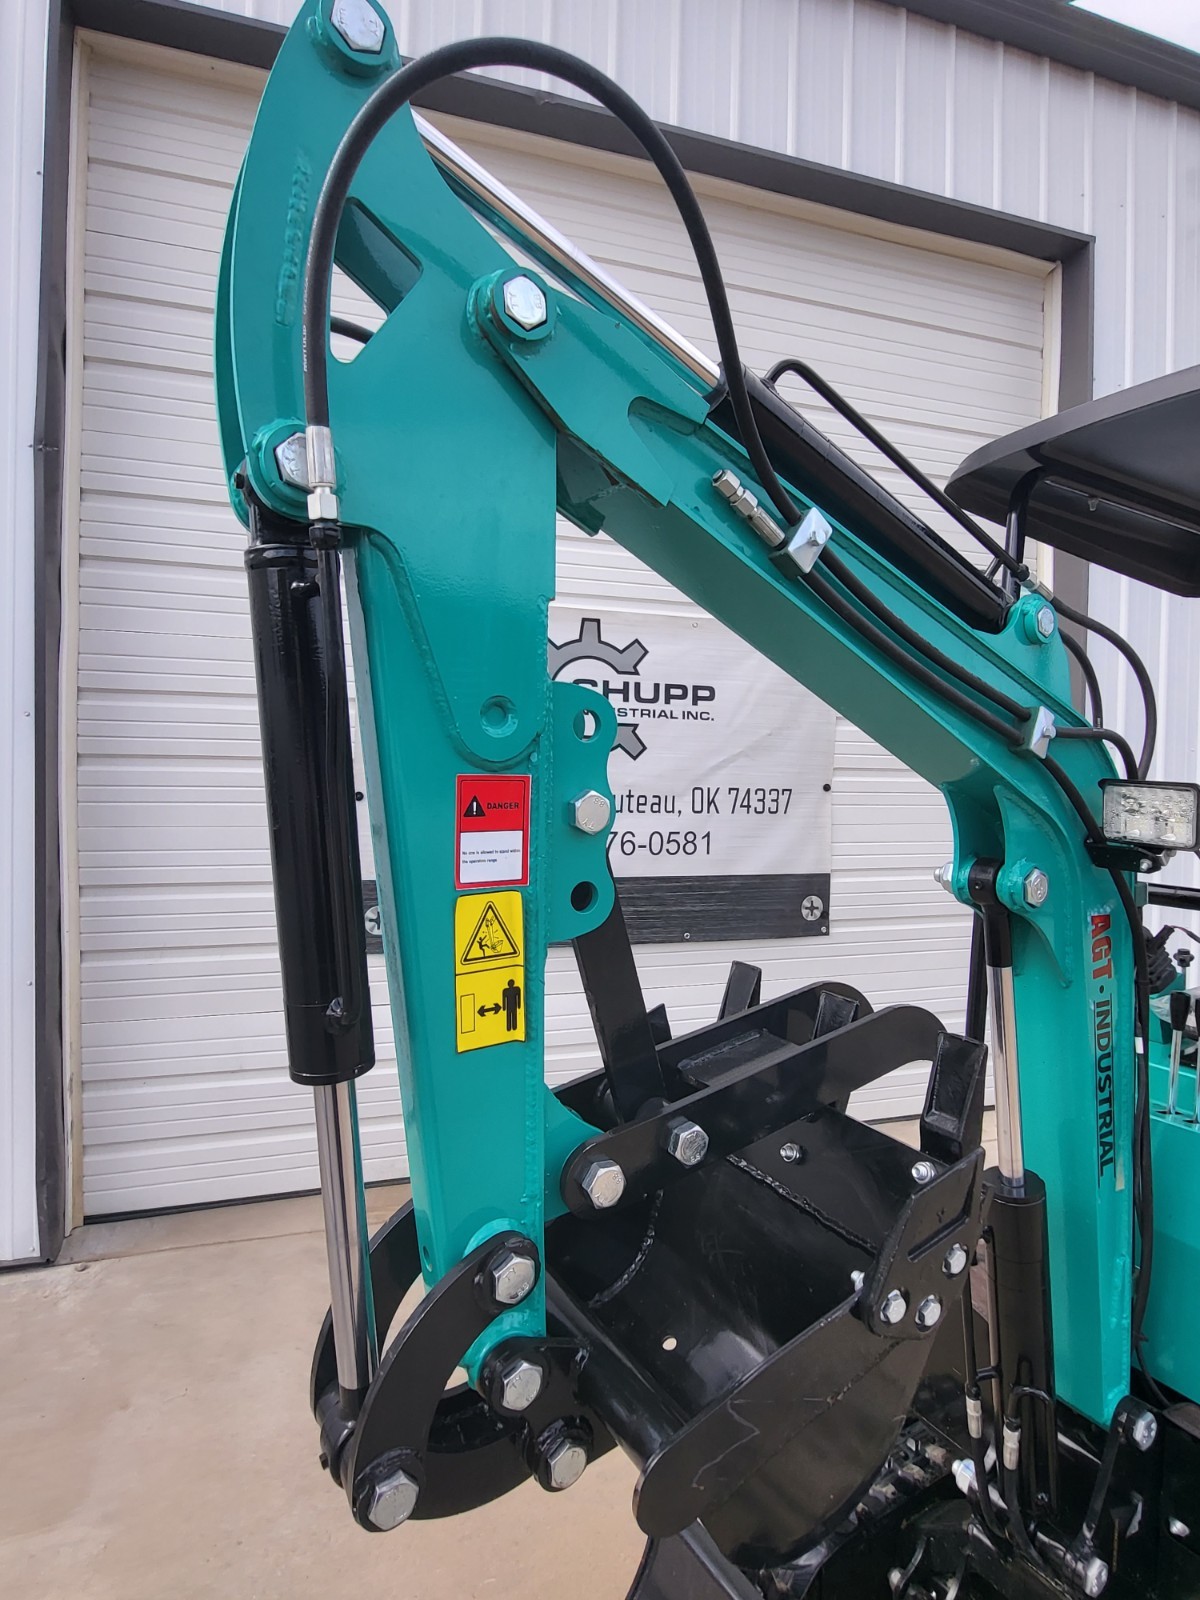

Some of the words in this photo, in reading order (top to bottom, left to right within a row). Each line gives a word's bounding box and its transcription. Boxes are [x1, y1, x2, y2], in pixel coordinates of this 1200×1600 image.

[613, 708, 679, 720] STRIAL
[682, 711, 715, 721] INC.
[487, 802, 519, 810] DANGER
[613, 789, 682, 818] uteau,
[691, 787, 720, 814] OK
[728, 787, 793, 814] 74337
[606, 830, 711, 856] 76-0581
[1090, 913, 1112, 980] AGT
[1096, 999, 1114, 1177] INDUSTRIAL
